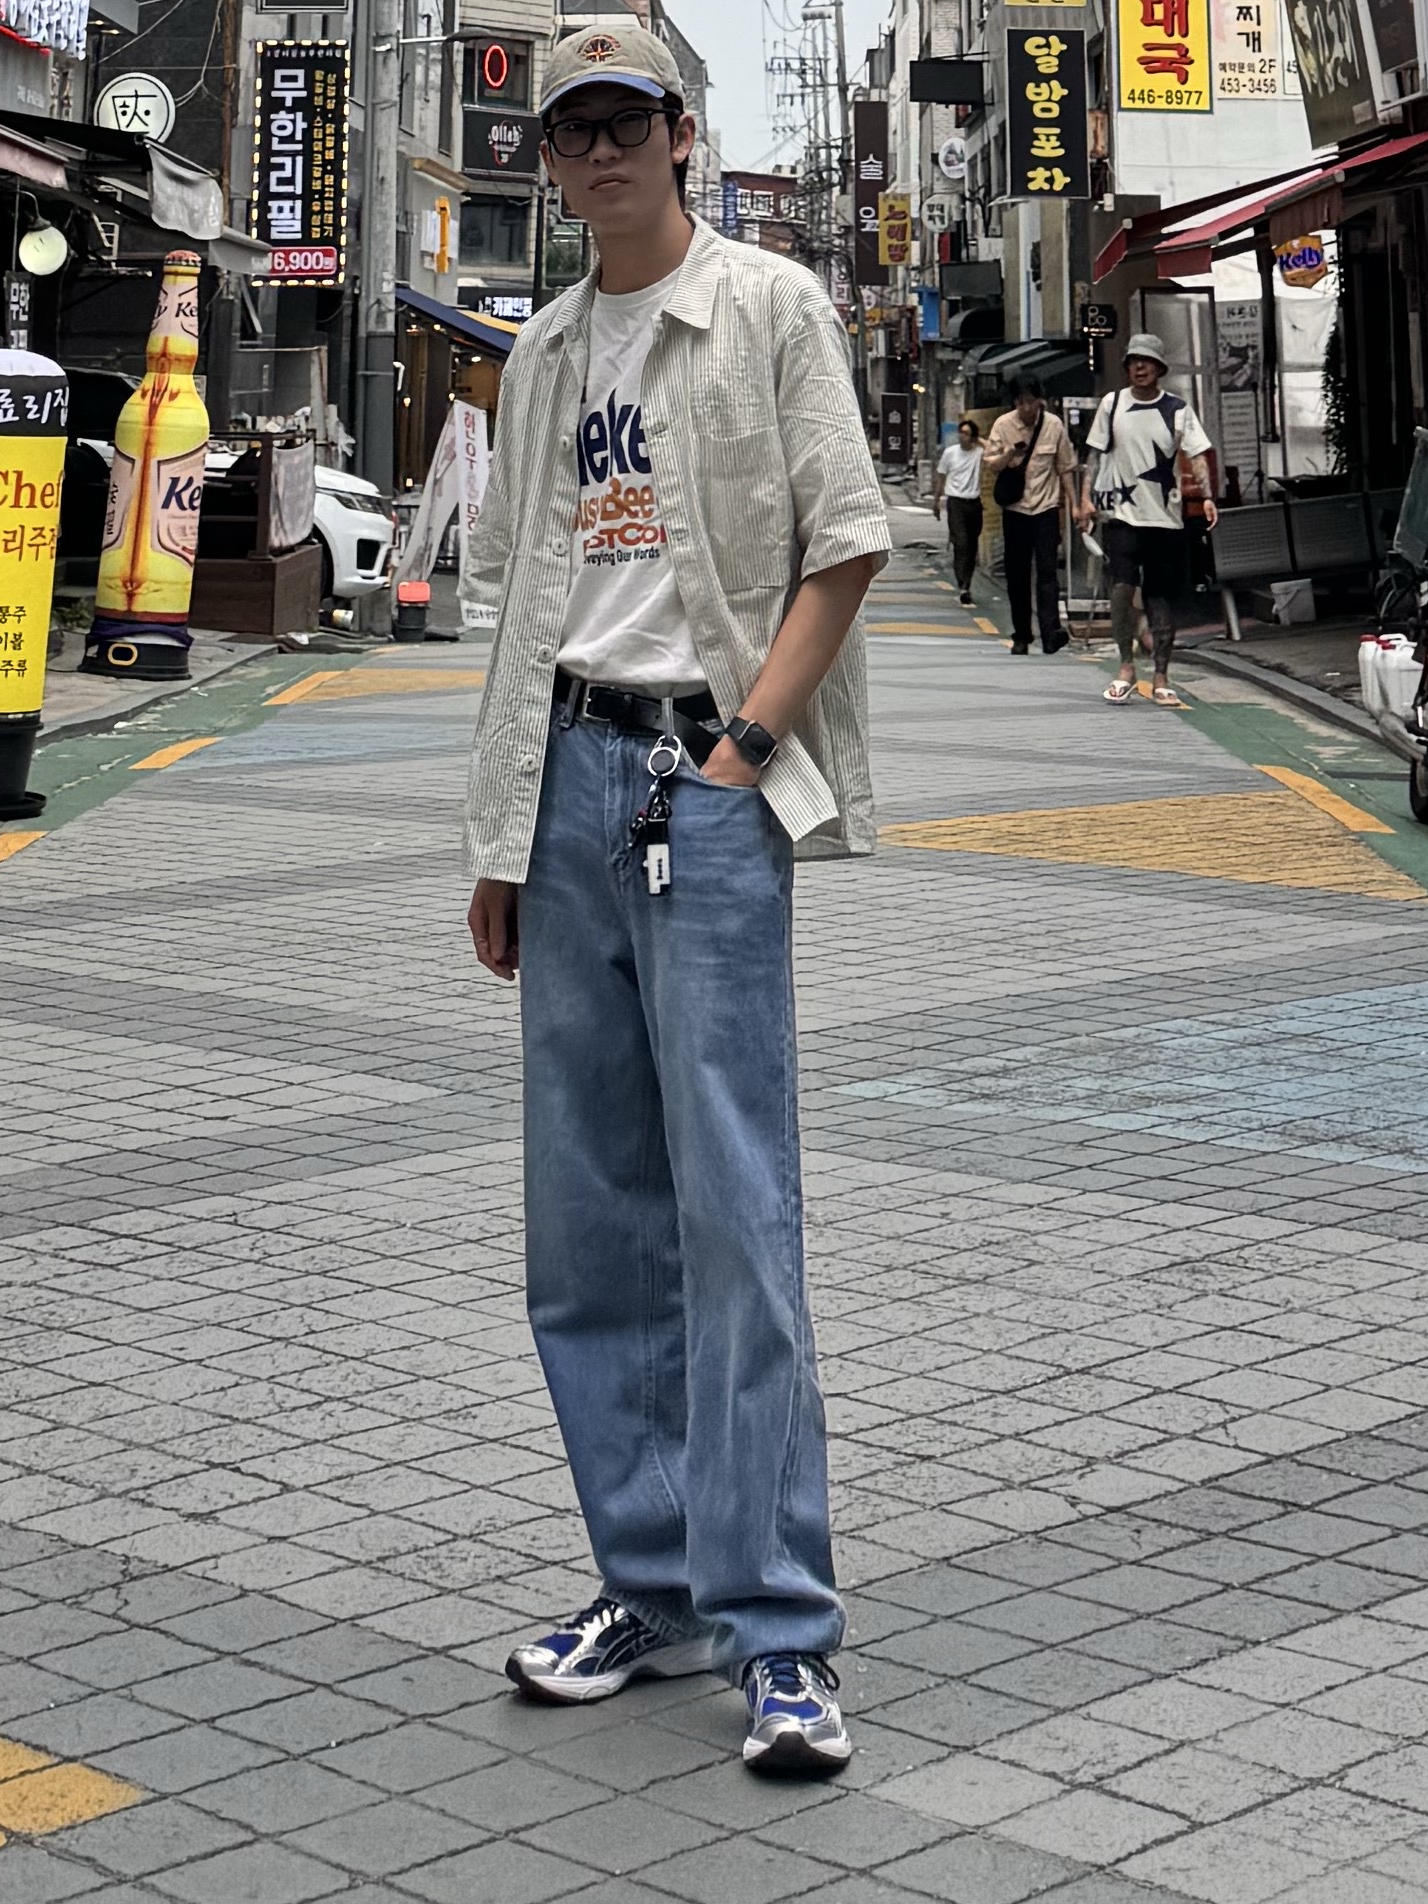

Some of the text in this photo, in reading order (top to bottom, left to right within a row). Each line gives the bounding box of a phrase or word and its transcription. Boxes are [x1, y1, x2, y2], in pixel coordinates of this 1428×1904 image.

[1259, 58, 1277, 74] 2F
[1126, 88, 1204, 107] 446-8977
[1219, 77, 1277, 95] 453-3456
[1023, 34, 1072, 193] 달밤포차
[266, 68, 308, 240] 무한리필
[1277, 242, 1325, 275] Kelly
